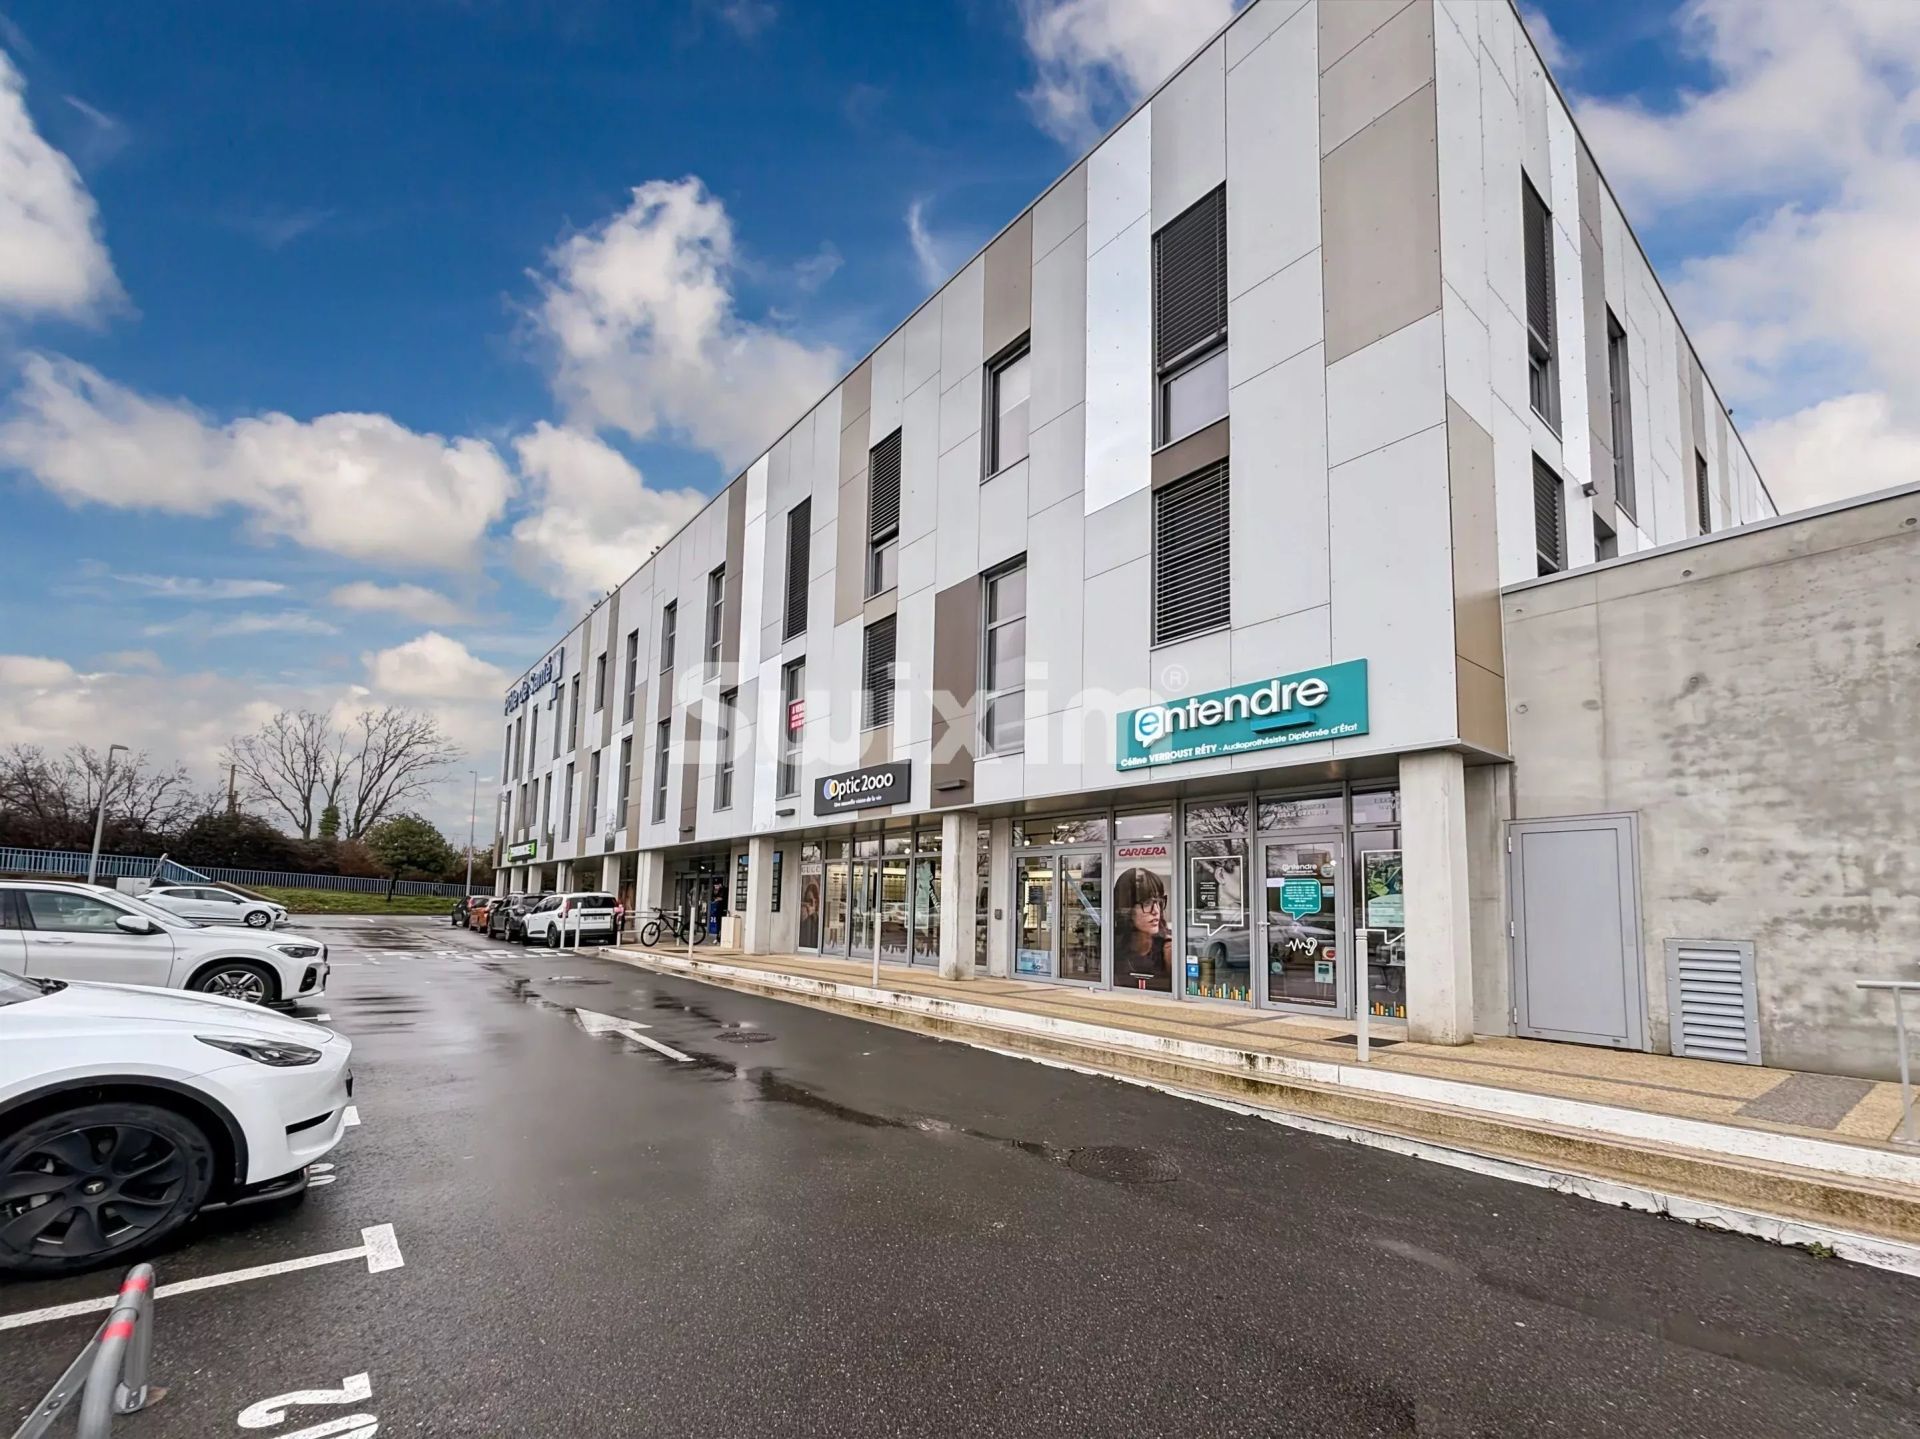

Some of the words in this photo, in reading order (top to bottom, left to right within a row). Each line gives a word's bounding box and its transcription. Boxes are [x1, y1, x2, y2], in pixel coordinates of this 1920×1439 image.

[1135, 678, 1329, 744] entendre
[1121, 756, 1147, 767] Céline
[1149, 749, 1193, 763] VERROUST
[1195, 743, 1217, 755] RÉTY
[1223, 735, 1287, 751] Audioprothésiste
[1288, 727, 1329, 742] Diplômée
[1331, 722, 1358, 734] d'État
[827, 776, 860, 800] Optic
[861, 773, 894, 791] 2000
[1118, 846, 1167, 857] CARRERA
[801, 865, 821, 873] GUCC
